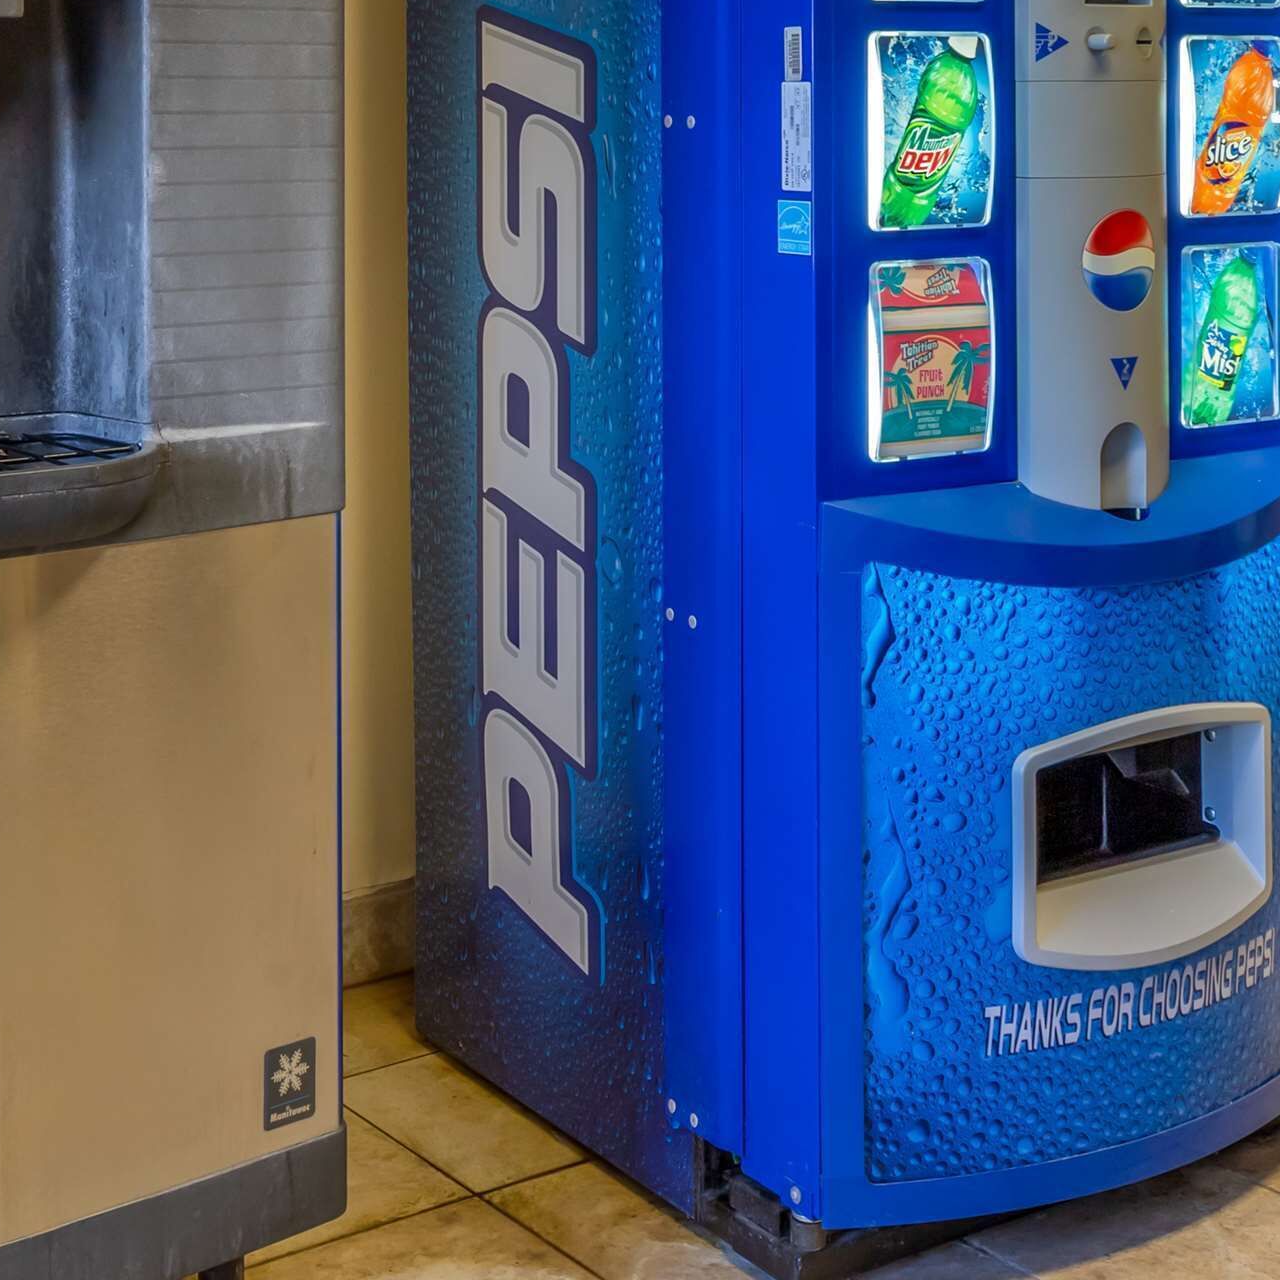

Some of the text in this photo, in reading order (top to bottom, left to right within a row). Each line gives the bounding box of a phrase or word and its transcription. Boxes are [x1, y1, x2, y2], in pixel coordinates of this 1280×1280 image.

[1205, 135, 1251, 166] slice
[481, 20, 589, 977] PEPSI
[984, 927, 1276, 1057] THANKS FOR CHOOSING PEPSI
